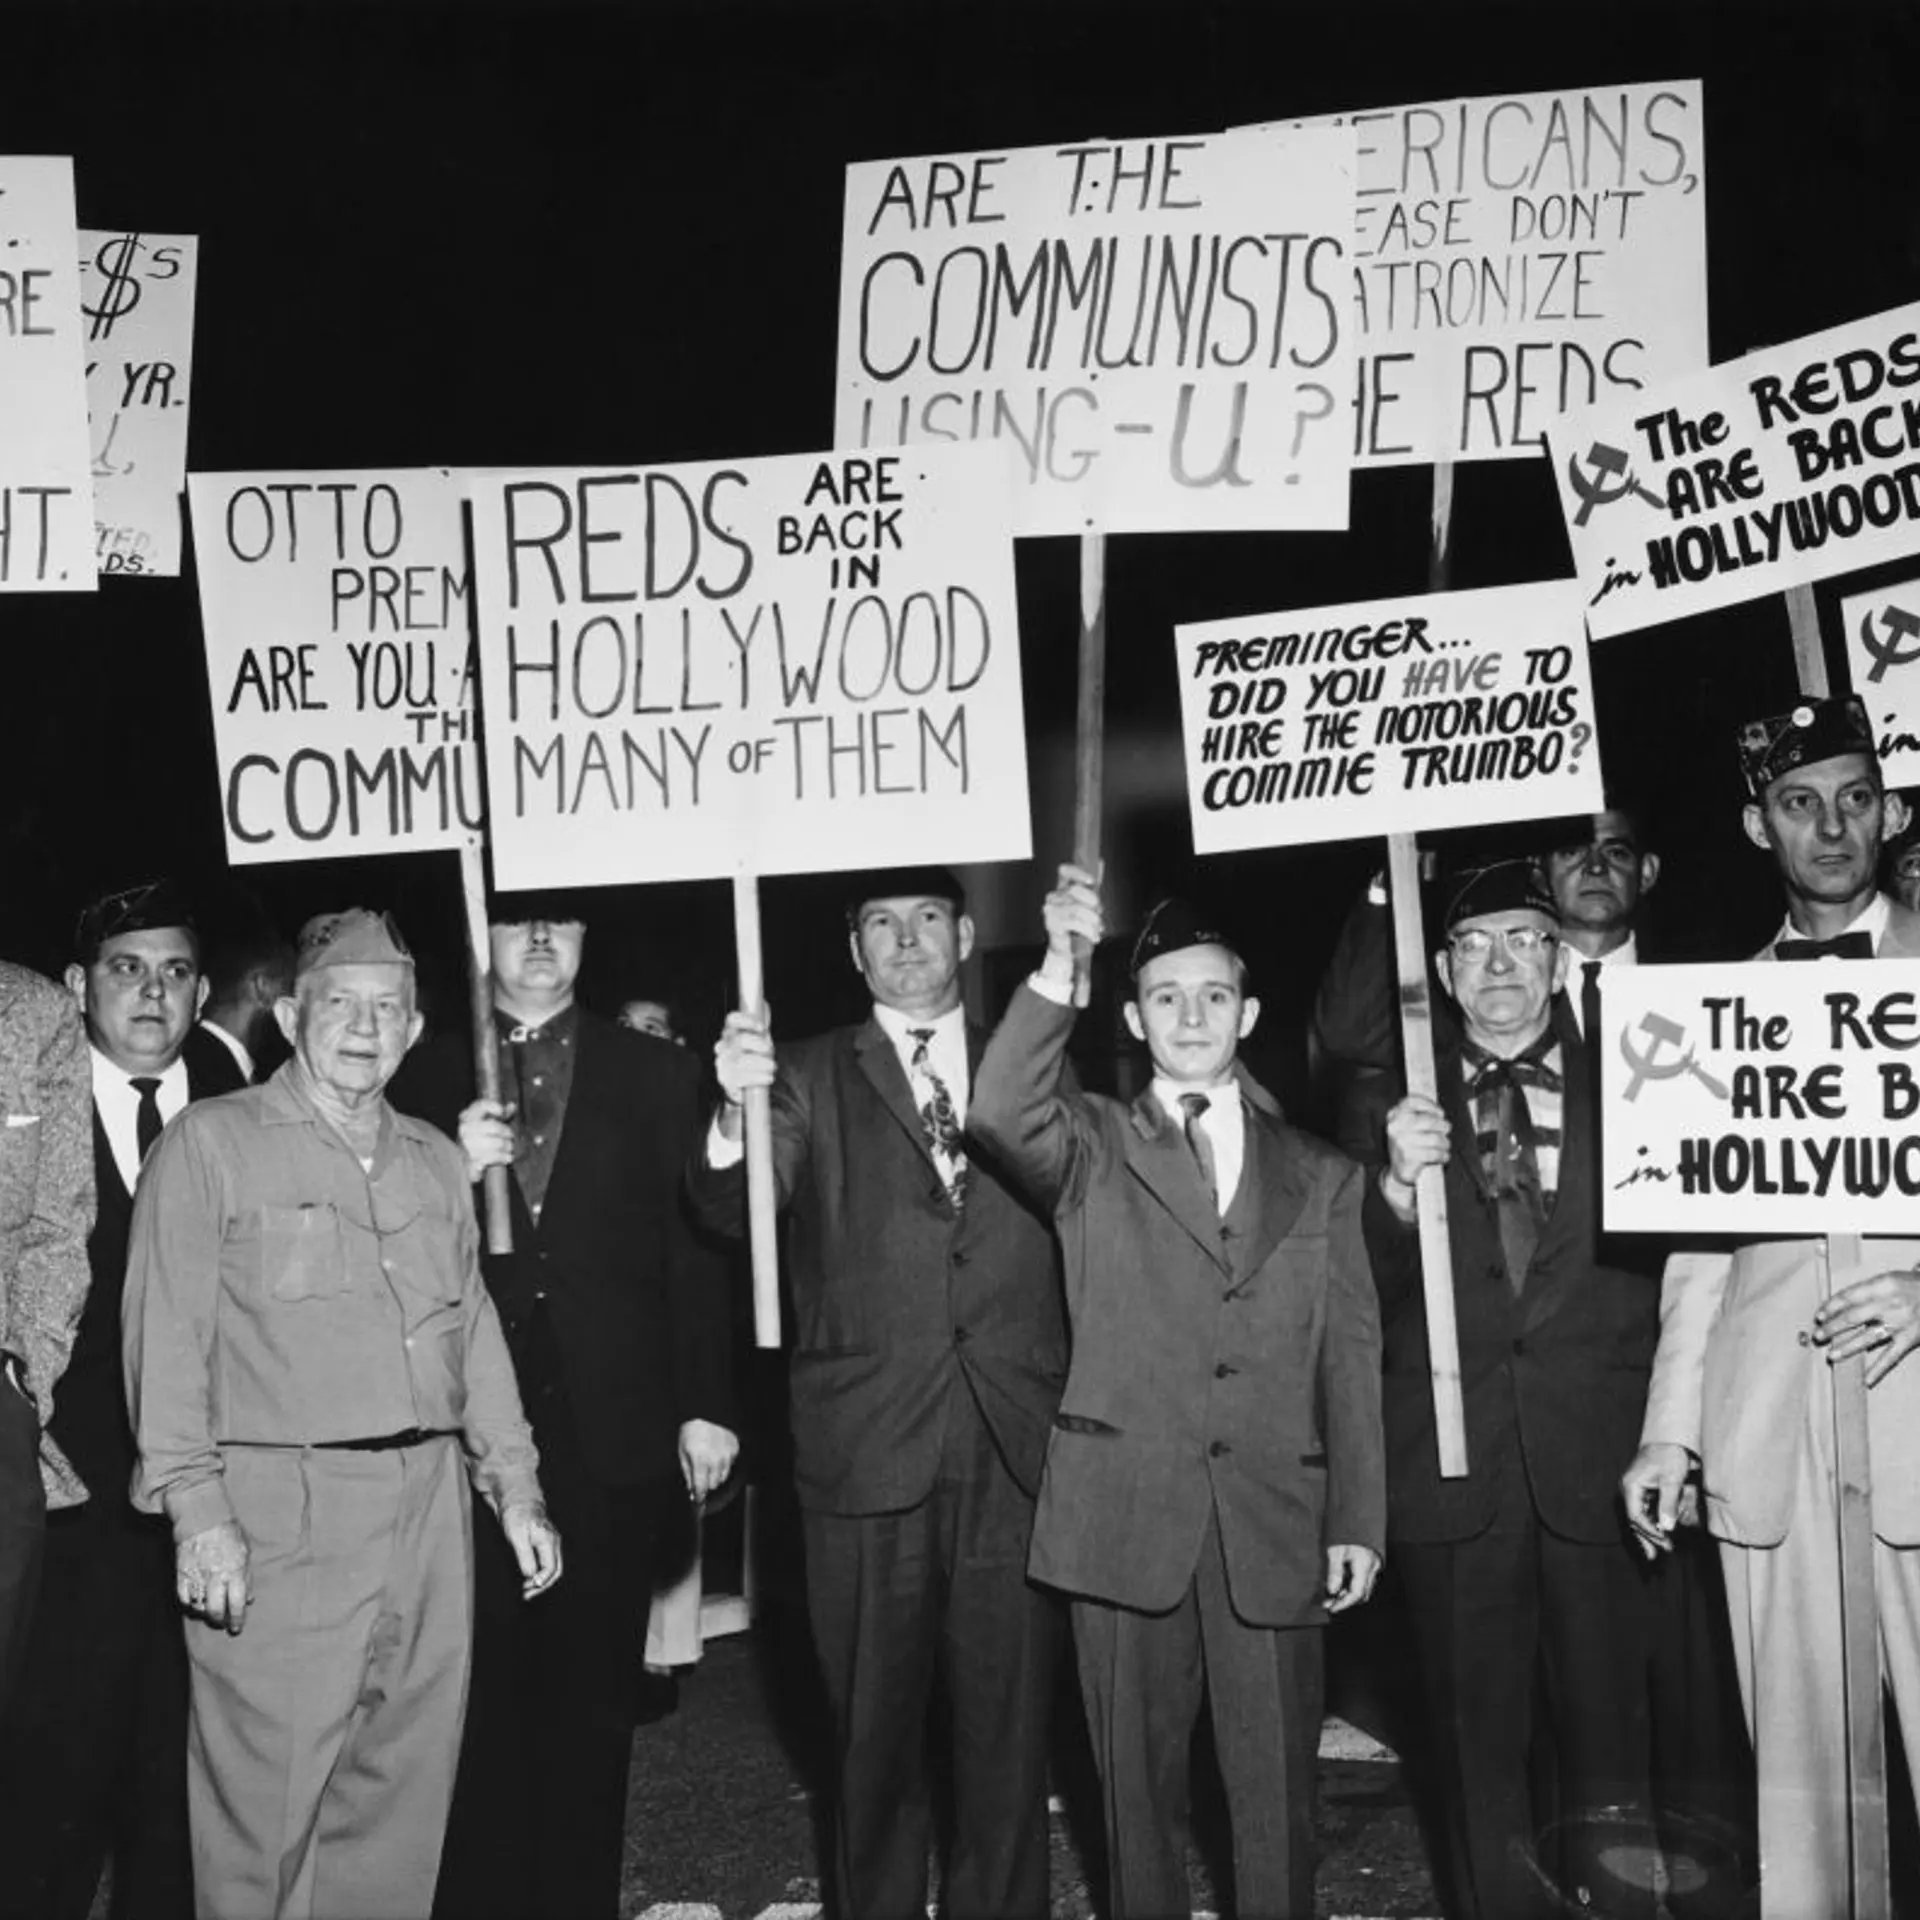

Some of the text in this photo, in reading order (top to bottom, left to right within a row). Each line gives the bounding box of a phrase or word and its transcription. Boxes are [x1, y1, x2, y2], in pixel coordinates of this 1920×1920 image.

[868, 157, 1007, 236] ARE
[1511, 191, 1644, 243] DON'T
[859, 234, 1343, 381] COMMUNISTS
[1635, 332, 1920, 462] The REDS
[804, 458, 903, 505] ARE
[1667, 448, 1764, 520] ARE
[227, 484, 403, 562] OTTO
[504, 470, 753, 608] REDS
[778, 508, 902, 555] BACK
[1589, 463, 1920, 607] in HOLLYWOOD
[831, 554, 880, 590] IN
[227, 645, 327, 713] ARE
[346, 642, 437, 710] YOU
[507, 585, 991, 722] HOLLYWOOD
[1209, 645, 1573, 719] DID YOU HAVE TO
[514, 704, 968, 817] MANY OF THEM
[1201, 686, 1577, 763] HIRE THE NOTORIOUS
[1203, 722, 1592, 812] COMMIE TRUMBO?
[1701, 992, 1920, 1052] The RE
[1731, 1063, 1848, 1120] ARE
[1613, 1145, 1673, 1191] in
